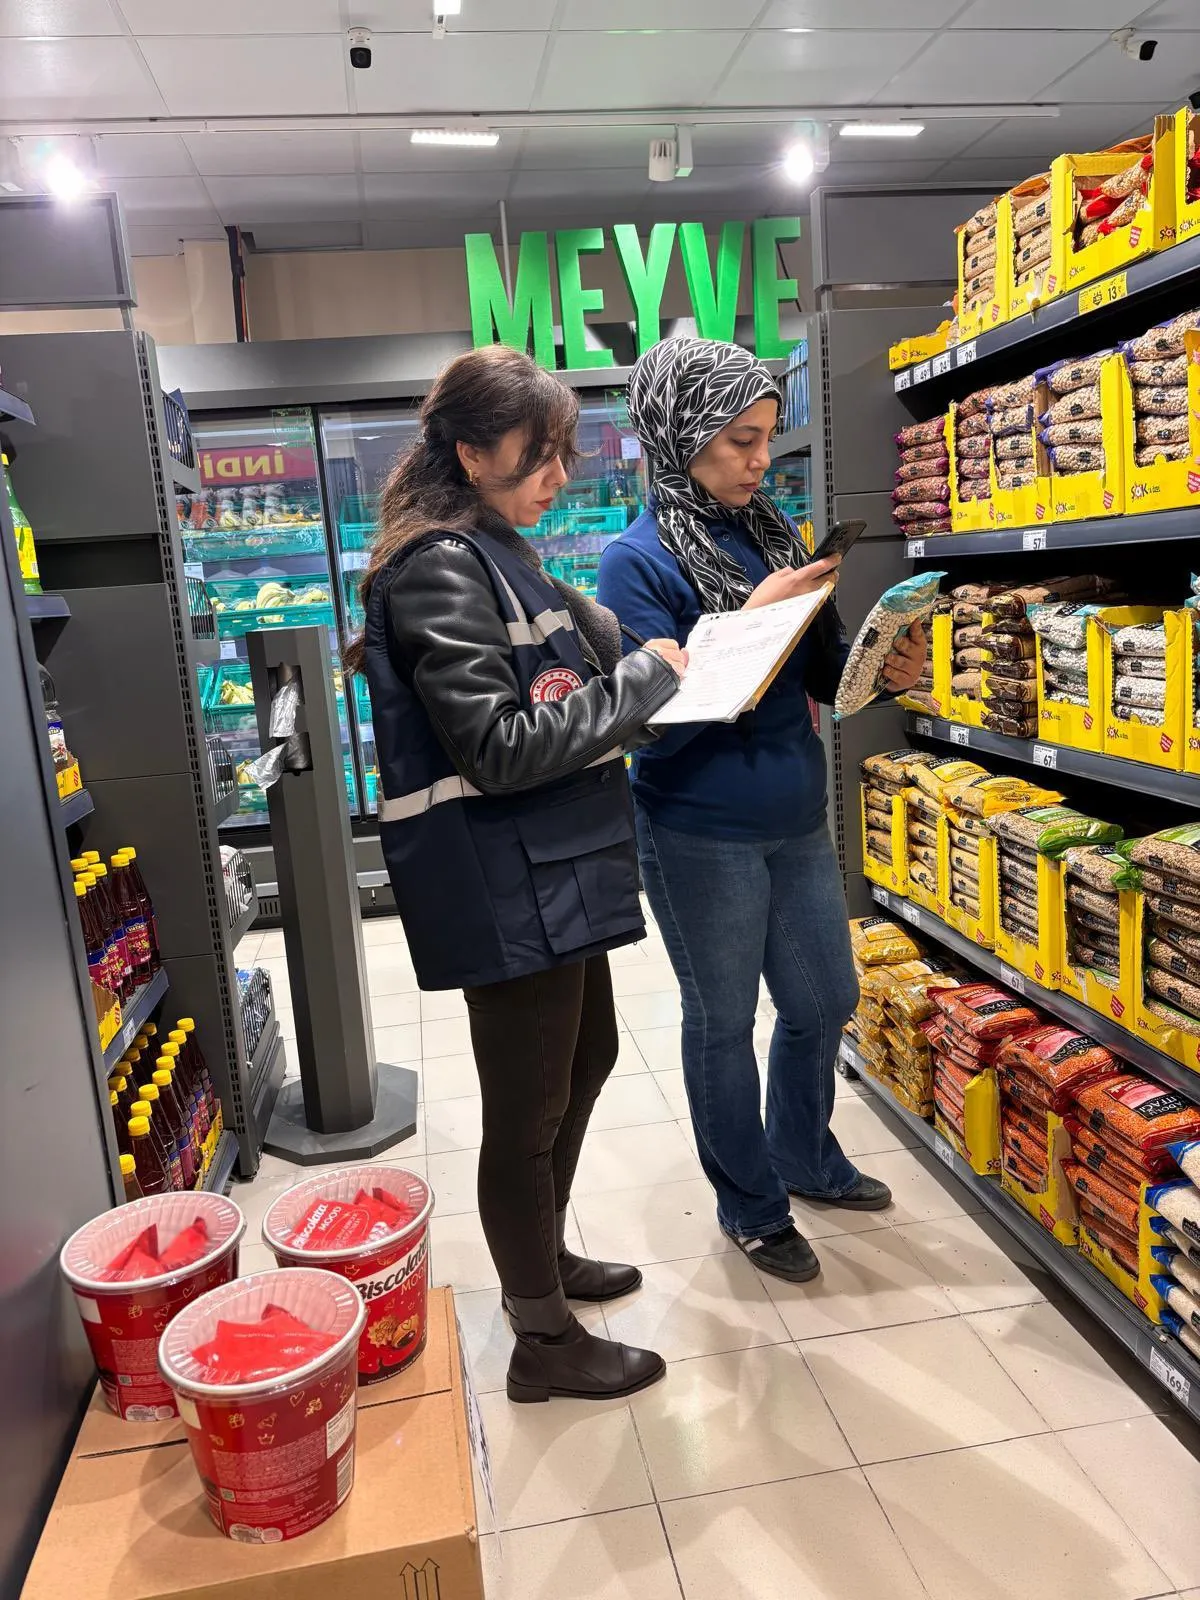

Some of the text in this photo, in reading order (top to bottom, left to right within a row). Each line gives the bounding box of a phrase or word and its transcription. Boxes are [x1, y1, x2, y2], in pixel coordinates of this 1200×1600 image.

[464, 217, 805, 371] MEYVE
[1108, 286, 1117, 301] 13
[964, 350, 972, 363] 29
[1033, 538, 1041, 550] 57
[958, 733, 966, 745] 28
[1043, 755, 1052, 767] 67
[1011, 975, 1020, 988] 67
[318, 1206, 342, 1231] MOOD
[1166, 1369, 1182, 1393] 169
